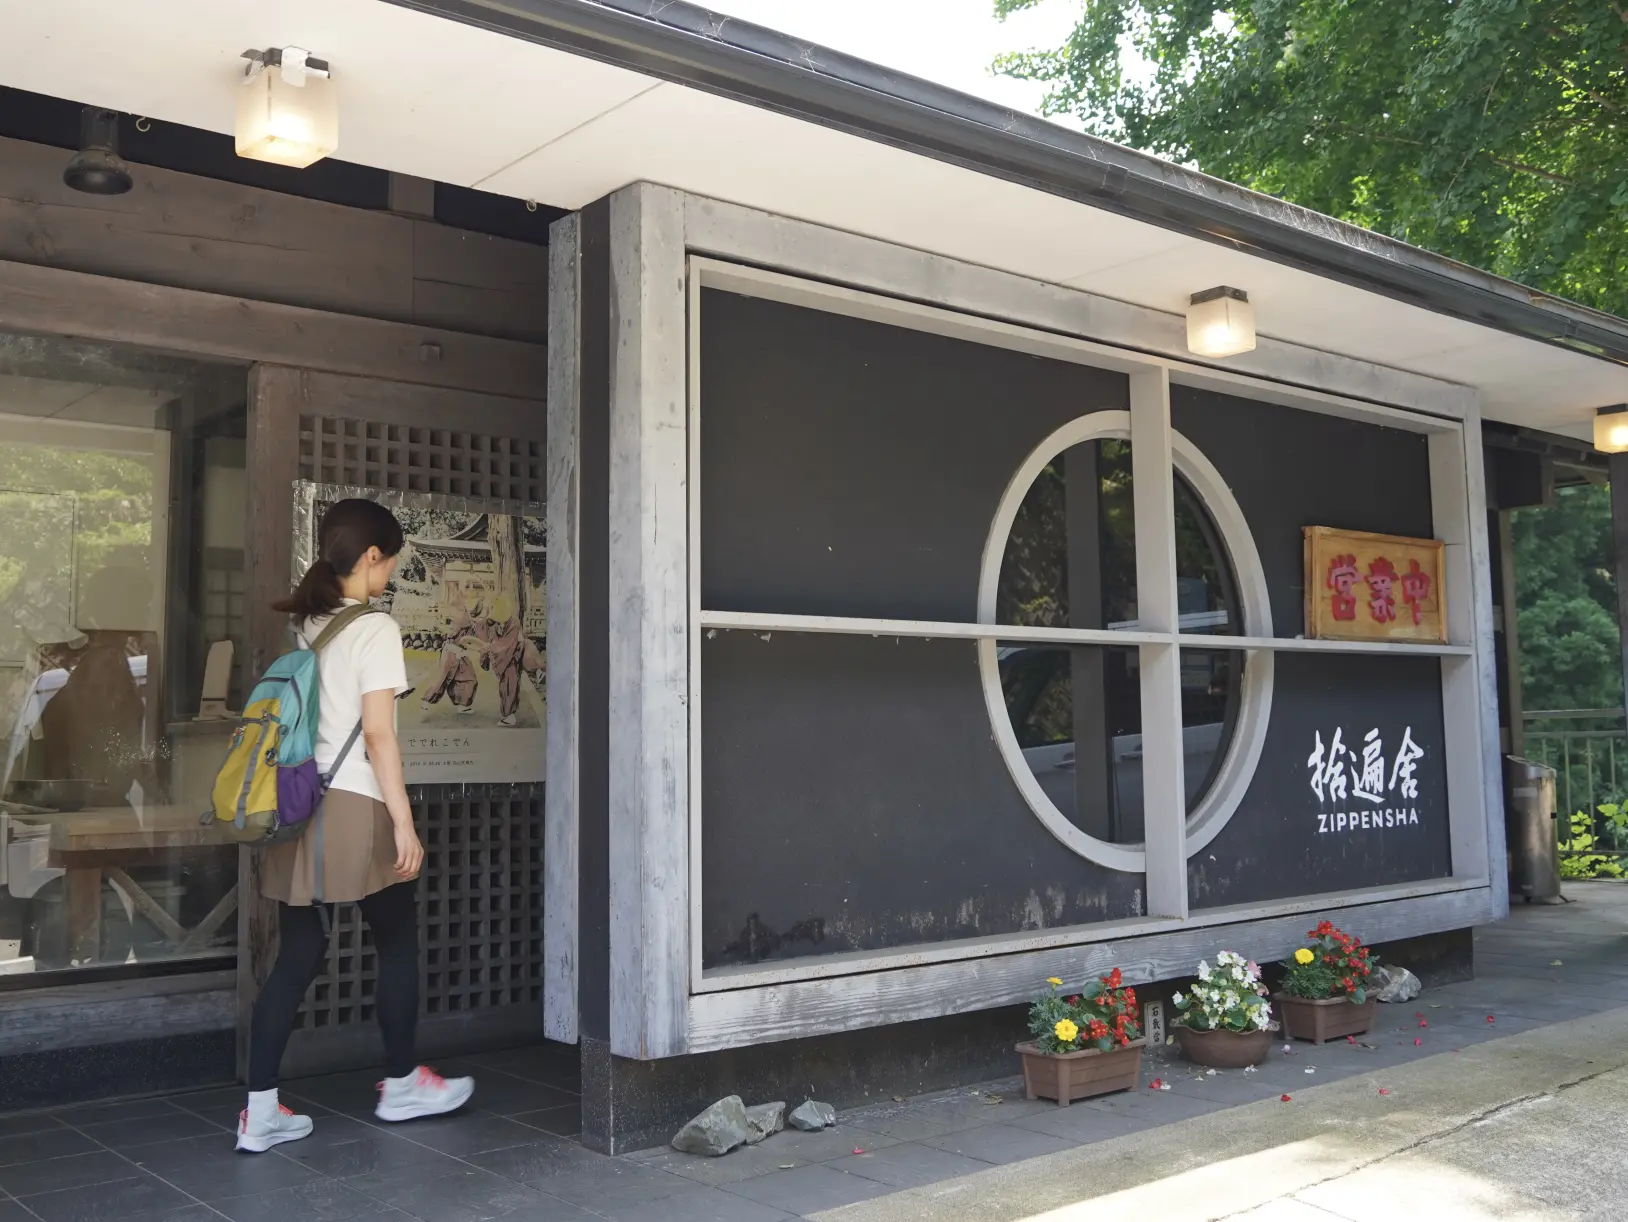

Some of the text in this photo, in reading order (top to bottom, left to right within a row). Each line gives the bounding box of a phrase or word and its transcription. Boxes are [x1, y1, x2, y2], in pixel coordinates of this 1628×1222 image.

[1325, 553, 1431, 626] 営業中
[1317, 807, 1419, 833] ZIPPENSHA
